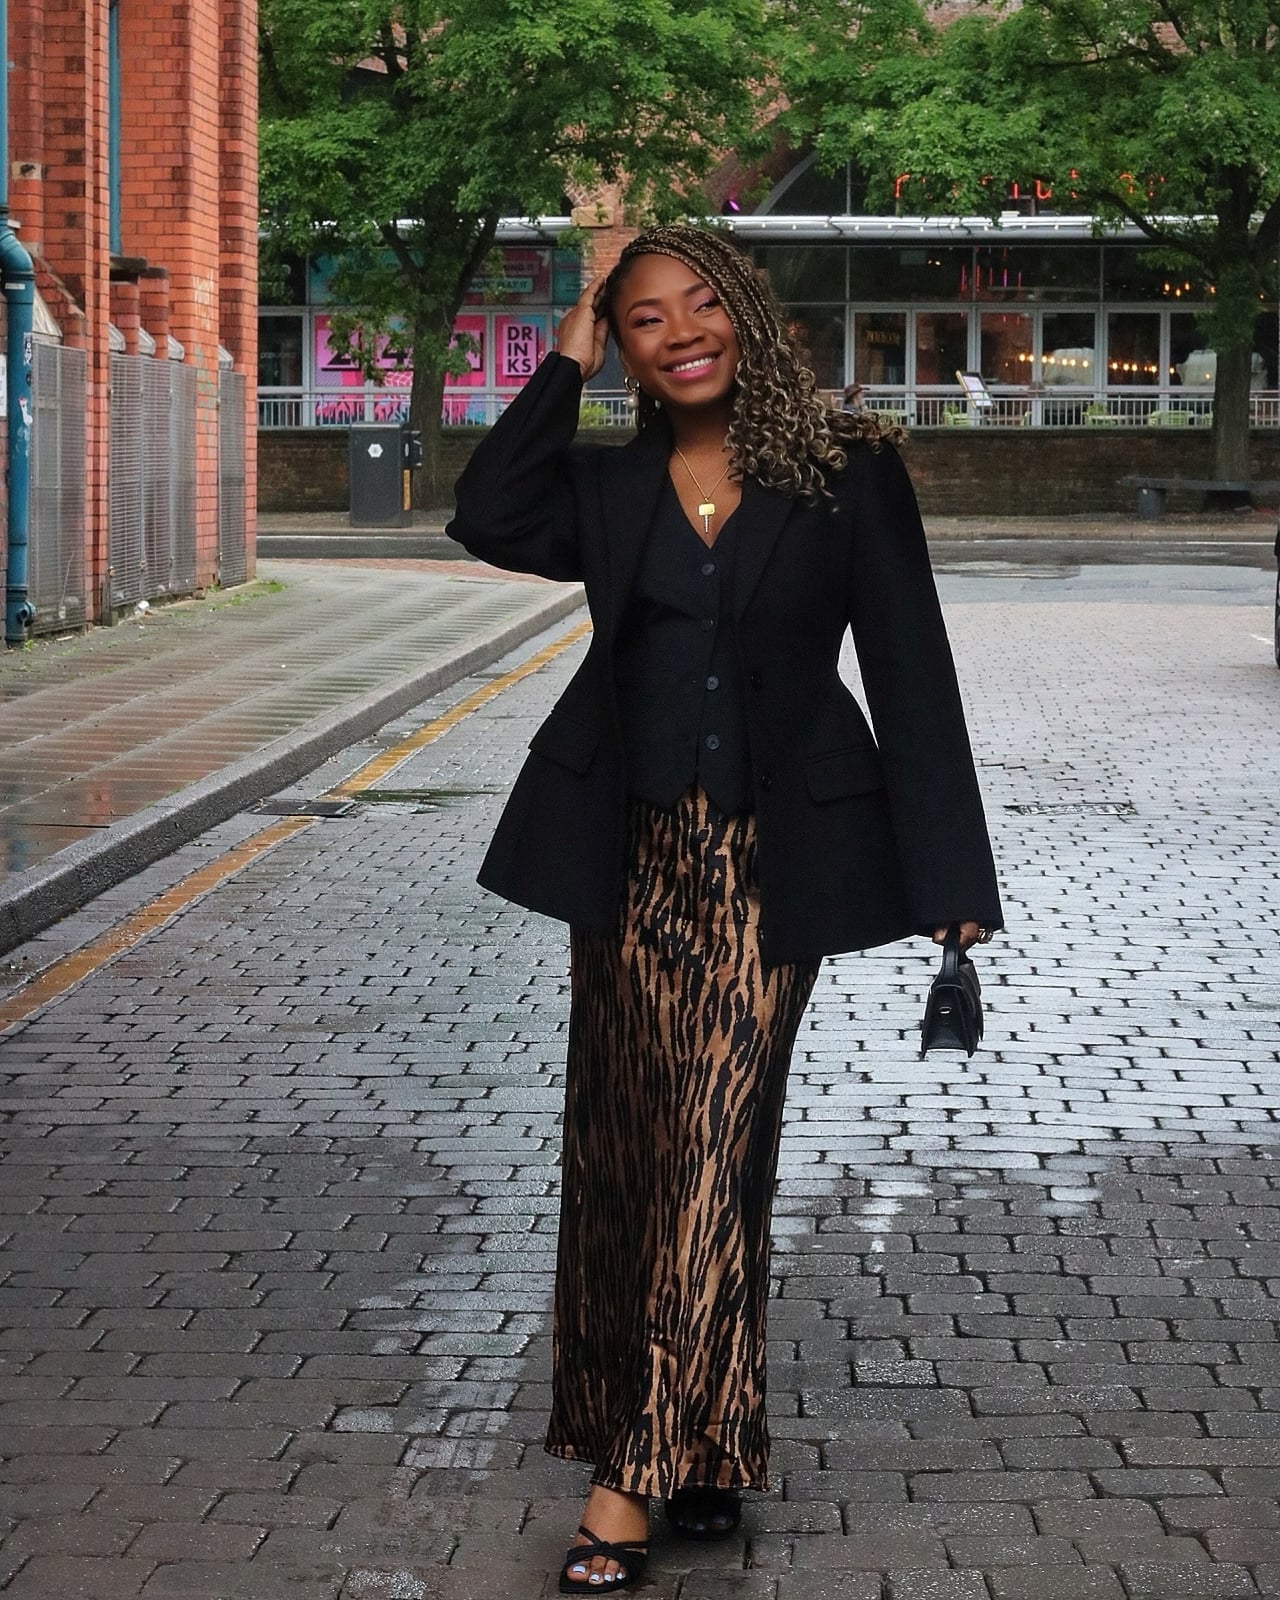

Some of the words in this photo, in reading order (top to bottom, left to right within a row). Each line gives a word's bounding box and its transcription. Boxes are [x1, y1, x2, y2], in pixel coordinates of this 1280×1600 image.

[507, 326, 533, 341] DR
[507, 342, 528, 357] IN
[507, 358, 532, 373] KS
